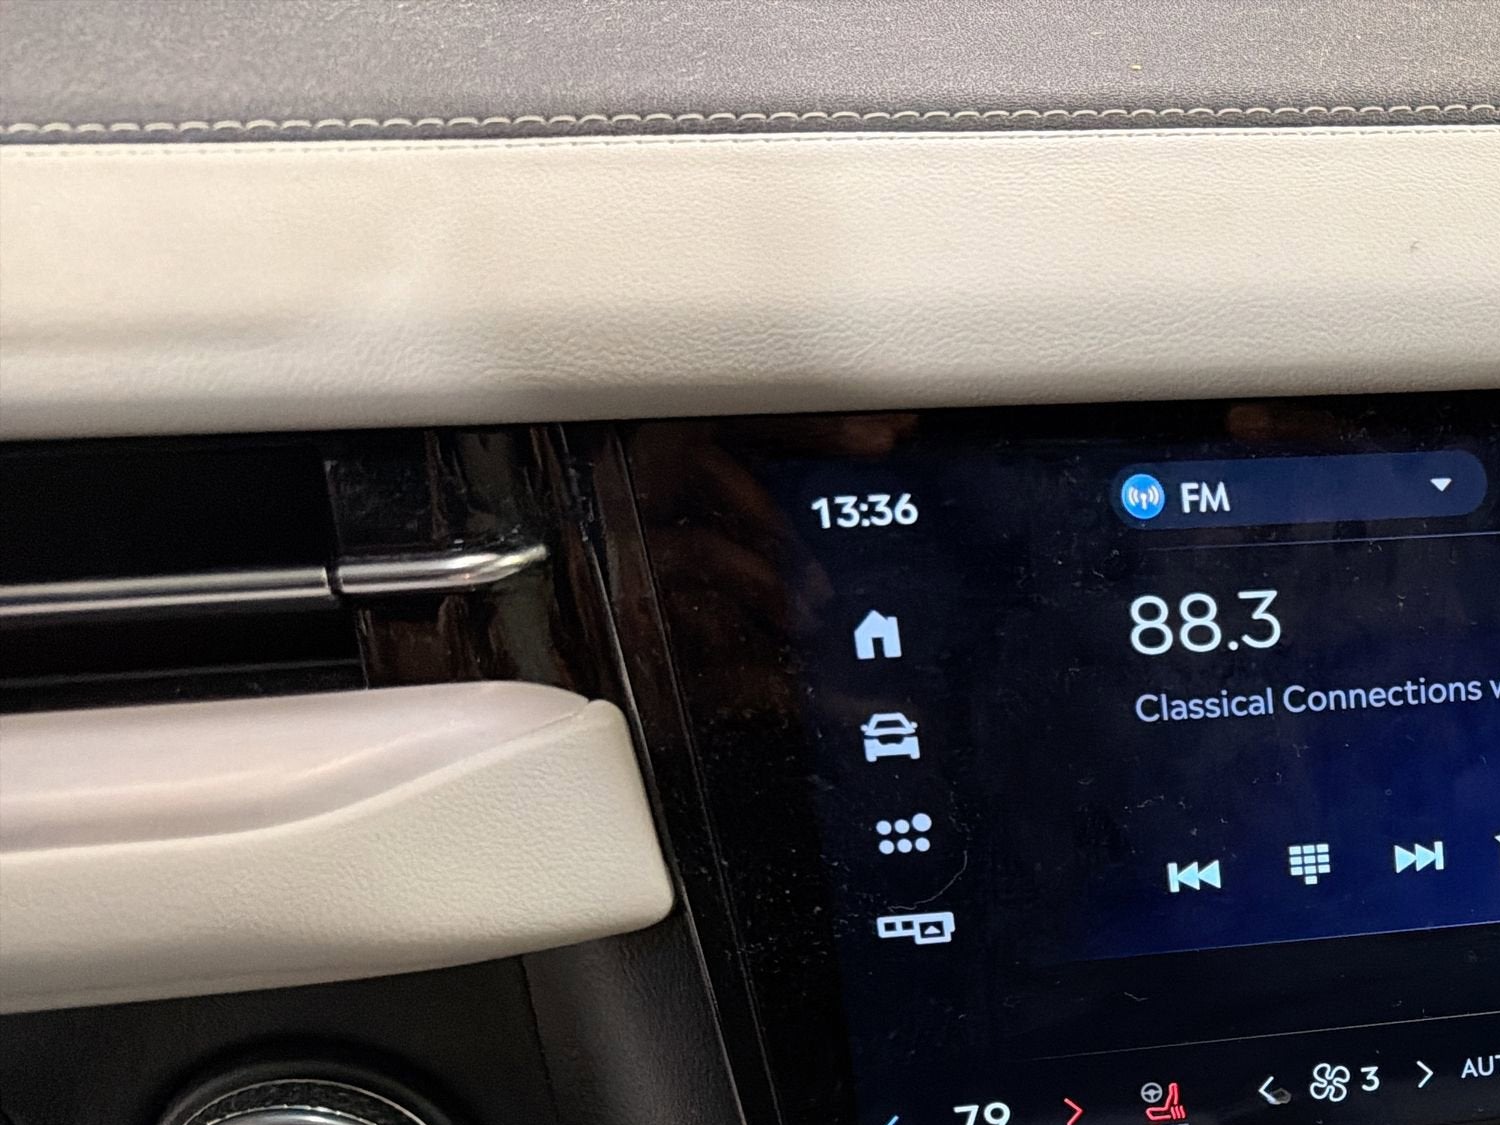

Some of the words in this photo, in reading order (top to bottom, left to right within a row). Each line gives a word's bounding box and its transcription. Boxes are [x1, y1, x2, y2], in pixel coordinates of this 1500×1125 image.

[811, 492, 919, 530] 13:36
[1180, 481, 1231, 514] FM
[1129, 589, 1282, 656] 88.3
[1135, 687, 1275, 722] Classical
[1283, 677, 1482, 713] Connections
[1360, 1066, 1381, 1092] 3
